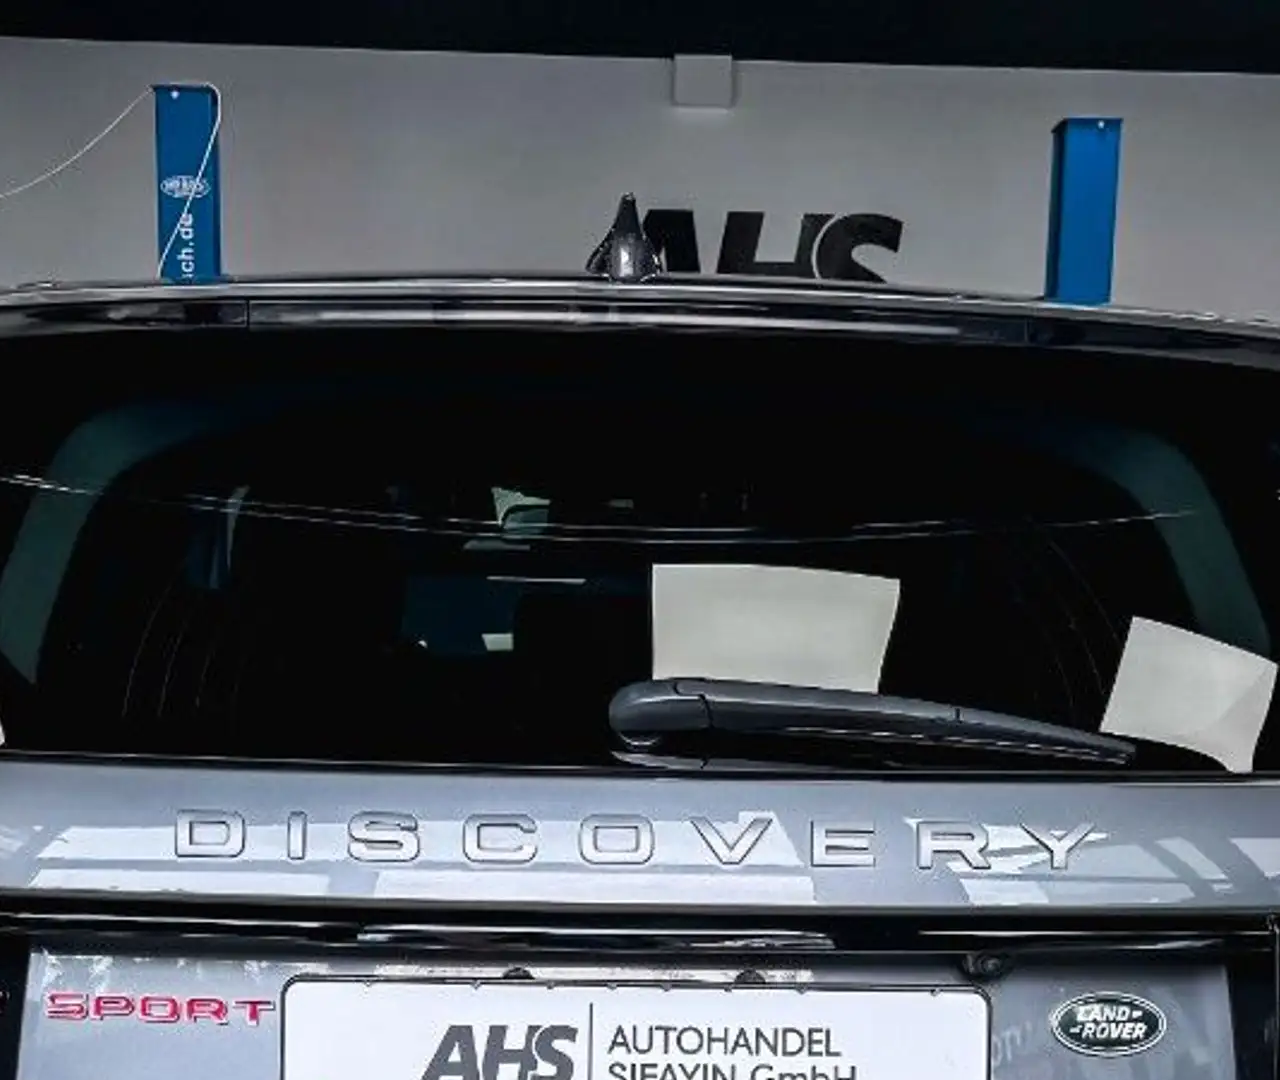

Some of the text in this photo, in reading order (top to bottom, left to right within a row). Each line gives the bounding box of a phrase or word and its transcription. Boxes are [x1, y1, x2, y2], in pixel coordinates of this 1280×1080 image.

[174, 808, 1096, 870] DISCOVERY
[46, 991, 276, 1026] SPORT
[607, 1024, 842, 1058] AUTOHANDEL
[1081, 1022, 1148, 1039] ROVER
